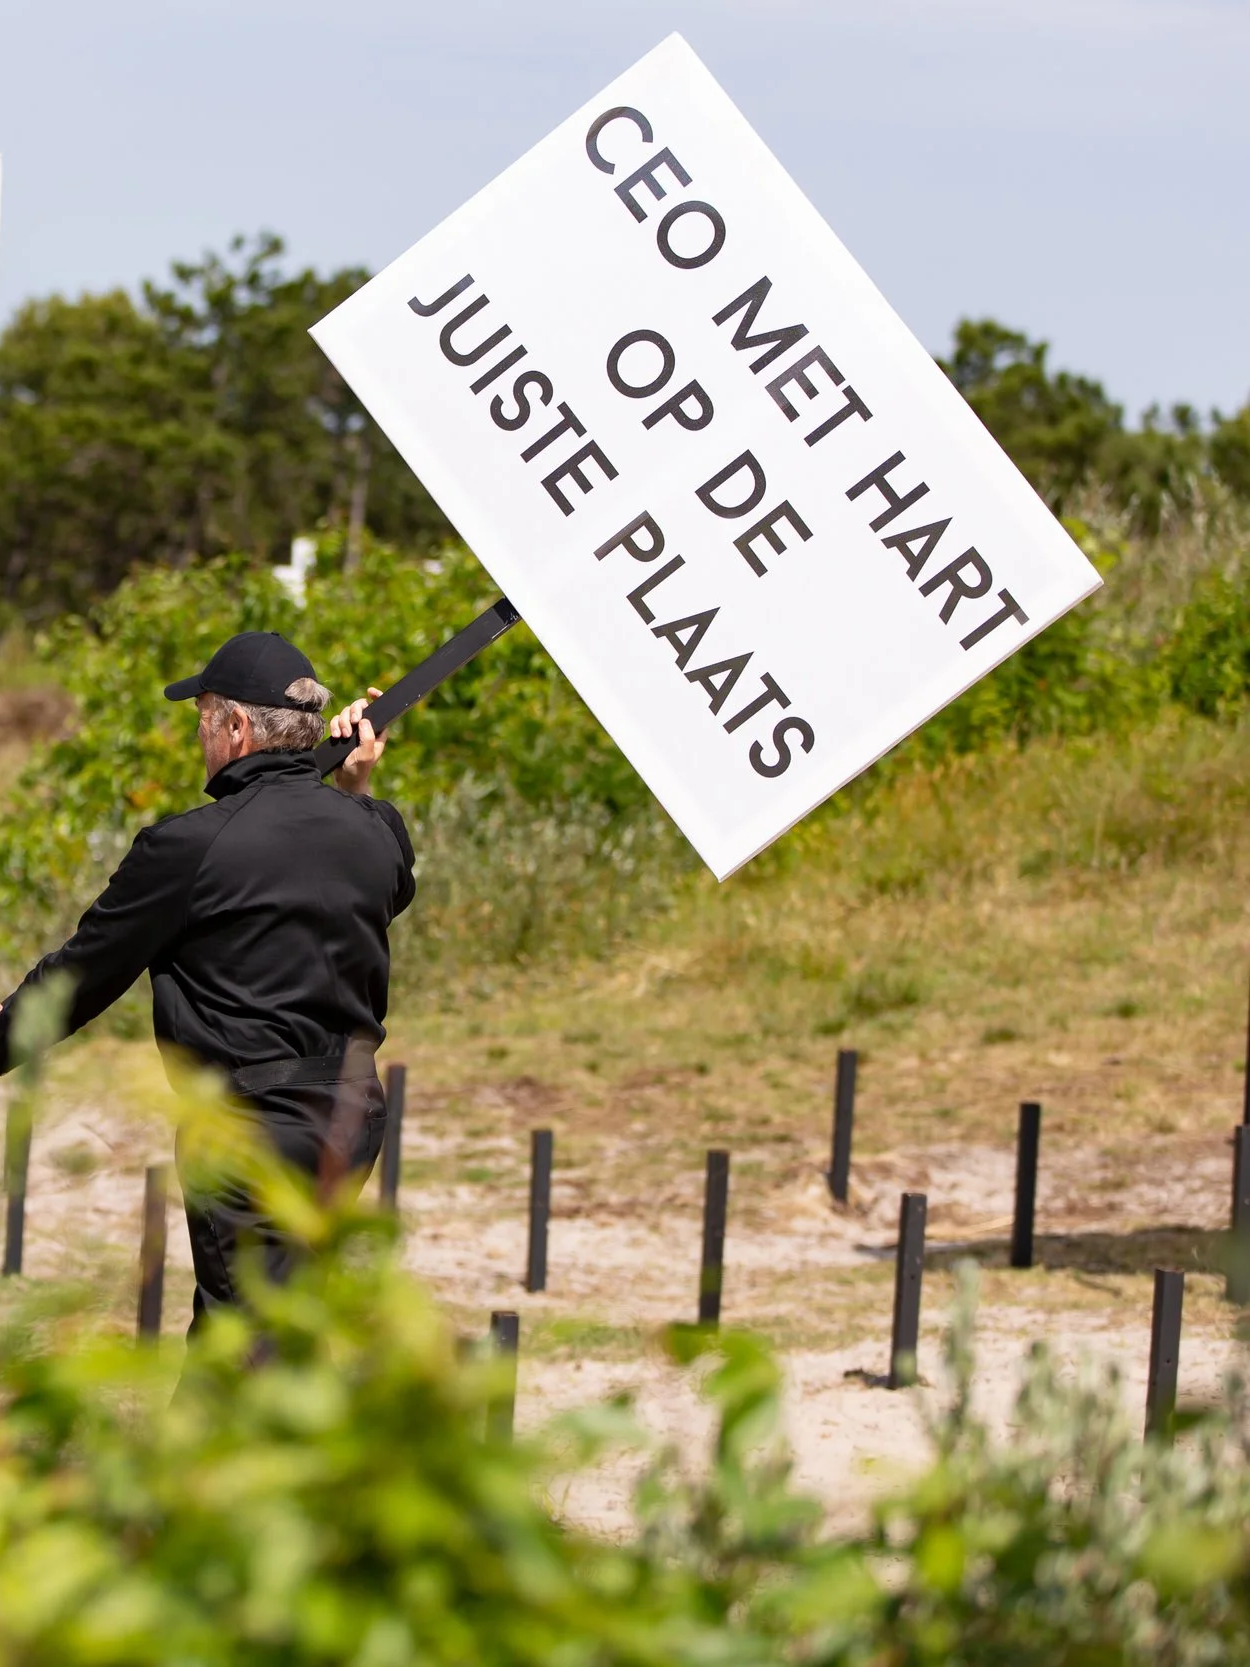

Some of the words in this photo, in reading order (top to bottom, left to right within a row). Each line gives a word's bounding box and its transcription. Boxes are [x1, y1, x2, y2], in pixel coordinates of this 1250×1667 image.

[407, 273, 620, 518] JUISTE
[593, 509, 815, 779] PLAATS
[585, 106, 727, 270] CEO
[711, 275, 874, 448] MET
[844, 449, 1030, 652] HART
[606, 329, 715, 432] OP
[694, 448, 814, 578] DE
